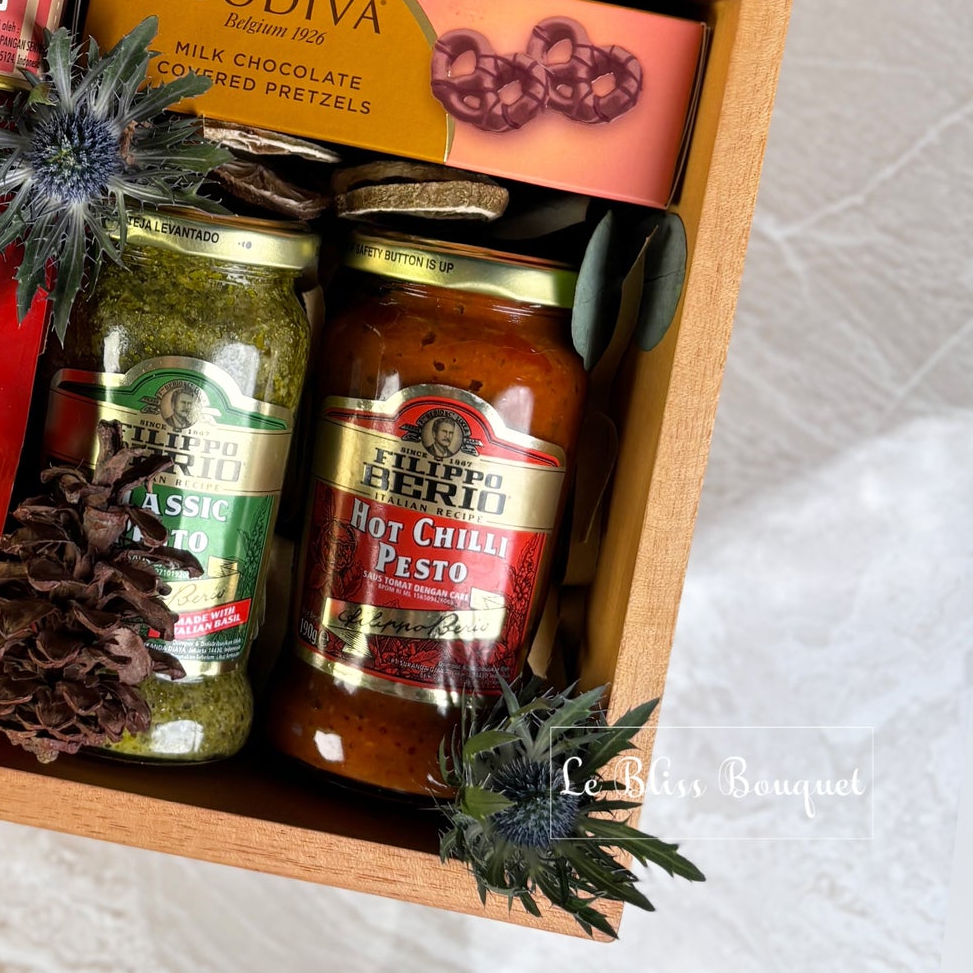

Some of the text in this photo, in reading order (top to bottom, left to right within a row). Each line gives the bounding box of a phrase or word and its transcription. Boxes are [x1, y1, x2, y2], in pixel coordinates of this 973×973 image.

[223, 12, 326, 46] Belgium 1926
[175, 41, 363, 90] MILK CHOCOLATE
[265, 81, 372, 115] PRETZELS
[154, 220, 220, 244] LEVANTADO
[355, 243, 455, 274] SAFETY BUTTON IS UP
[400, 446, 427, 458] SINCE
[373, 447, 503, 490] FILIPPO
[360, 462, 507, 516] BERIO
[374, 492, 484, 524] ITALIAN RECIPE
[384, 575, 413, 591] TOMAT
[413, 581, 448, 598] DENGAN
[210, 605, 236, 620] WITH
[214, 614, 241, 629] BASIL
